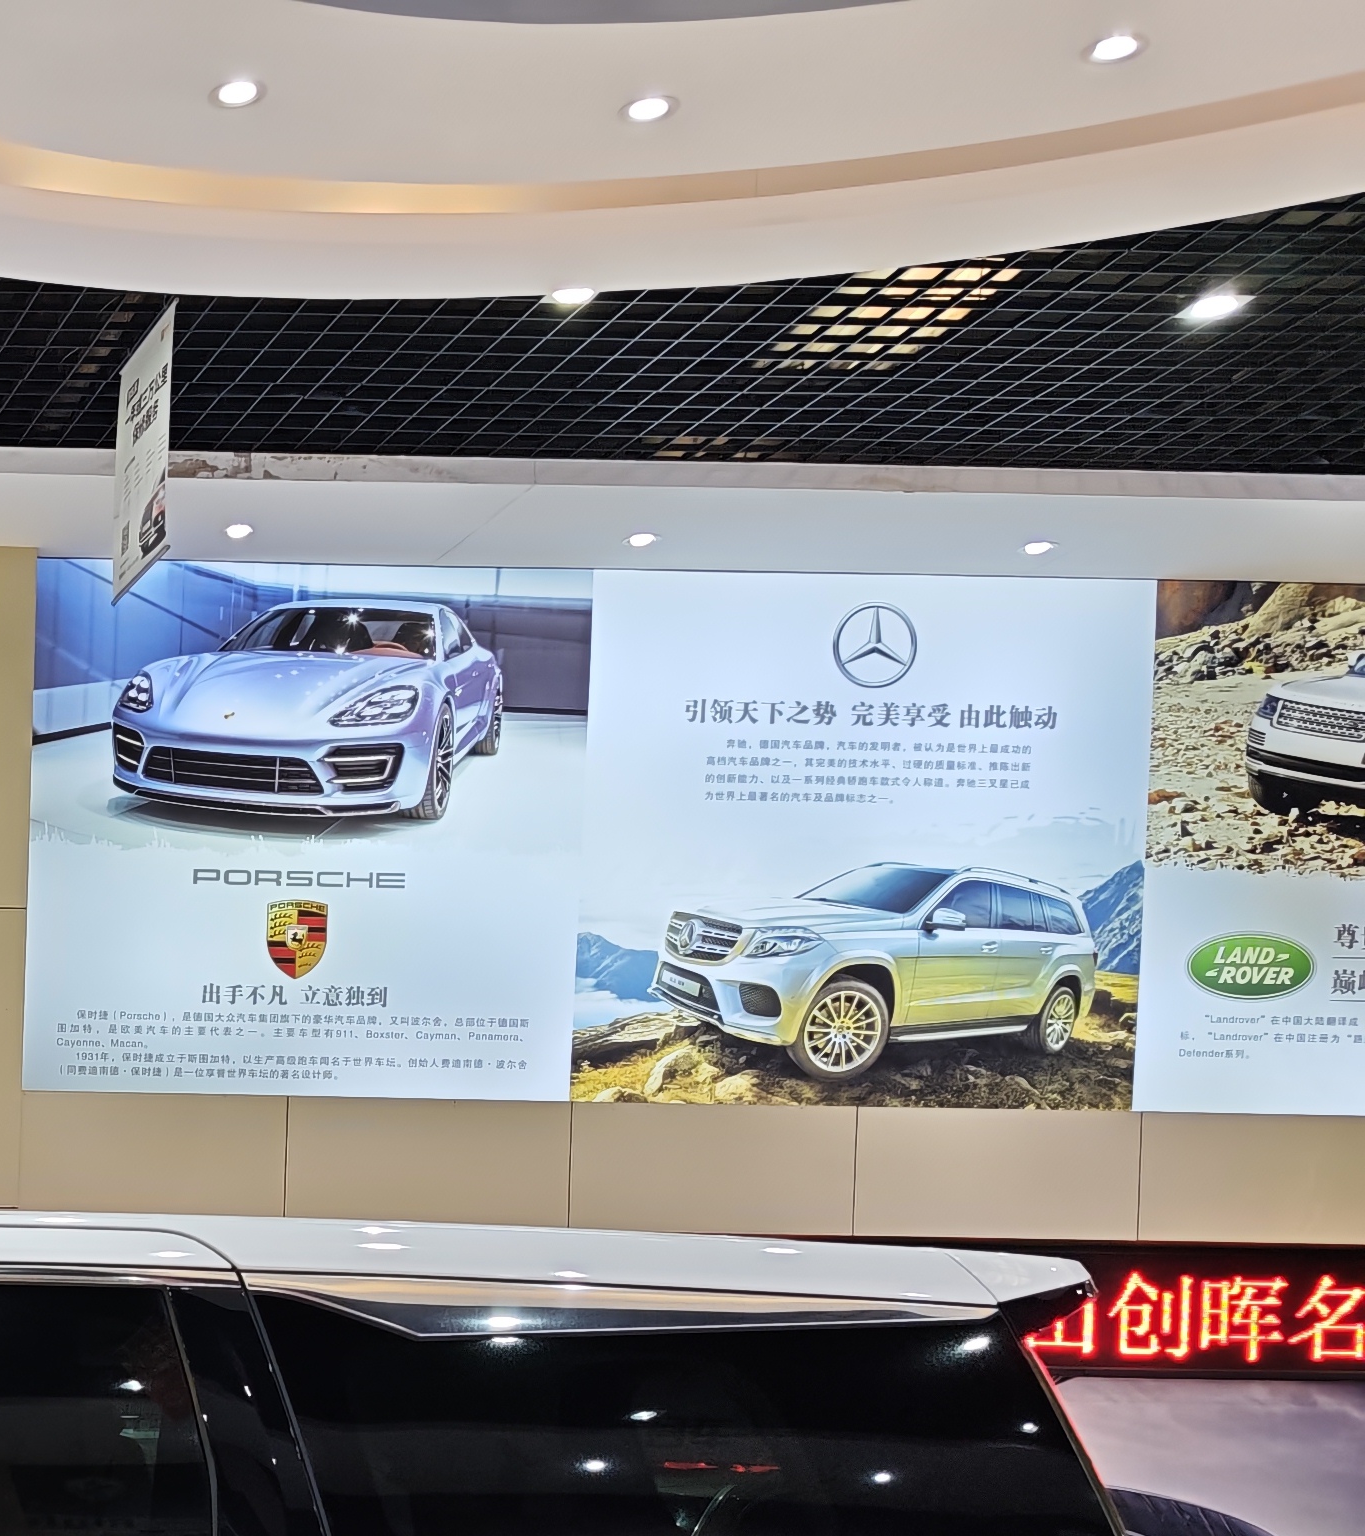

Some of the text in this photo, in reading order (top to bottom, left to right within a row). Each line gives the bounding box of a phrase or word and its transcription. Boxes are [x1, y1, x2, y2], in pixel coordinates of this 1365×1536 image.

[685, 699, 1057, 729] 引领天下之势 完美享受 由此触动
[193, 868, 406, 889] PORSCHE
[269, 901, 326, 913] PORSCHE
[1213, 946, 1276, 965] LAND
[1218, 967, 1295, 984] ROVER
[202, 983, 388, 1008] 出手不凡 立意独到
